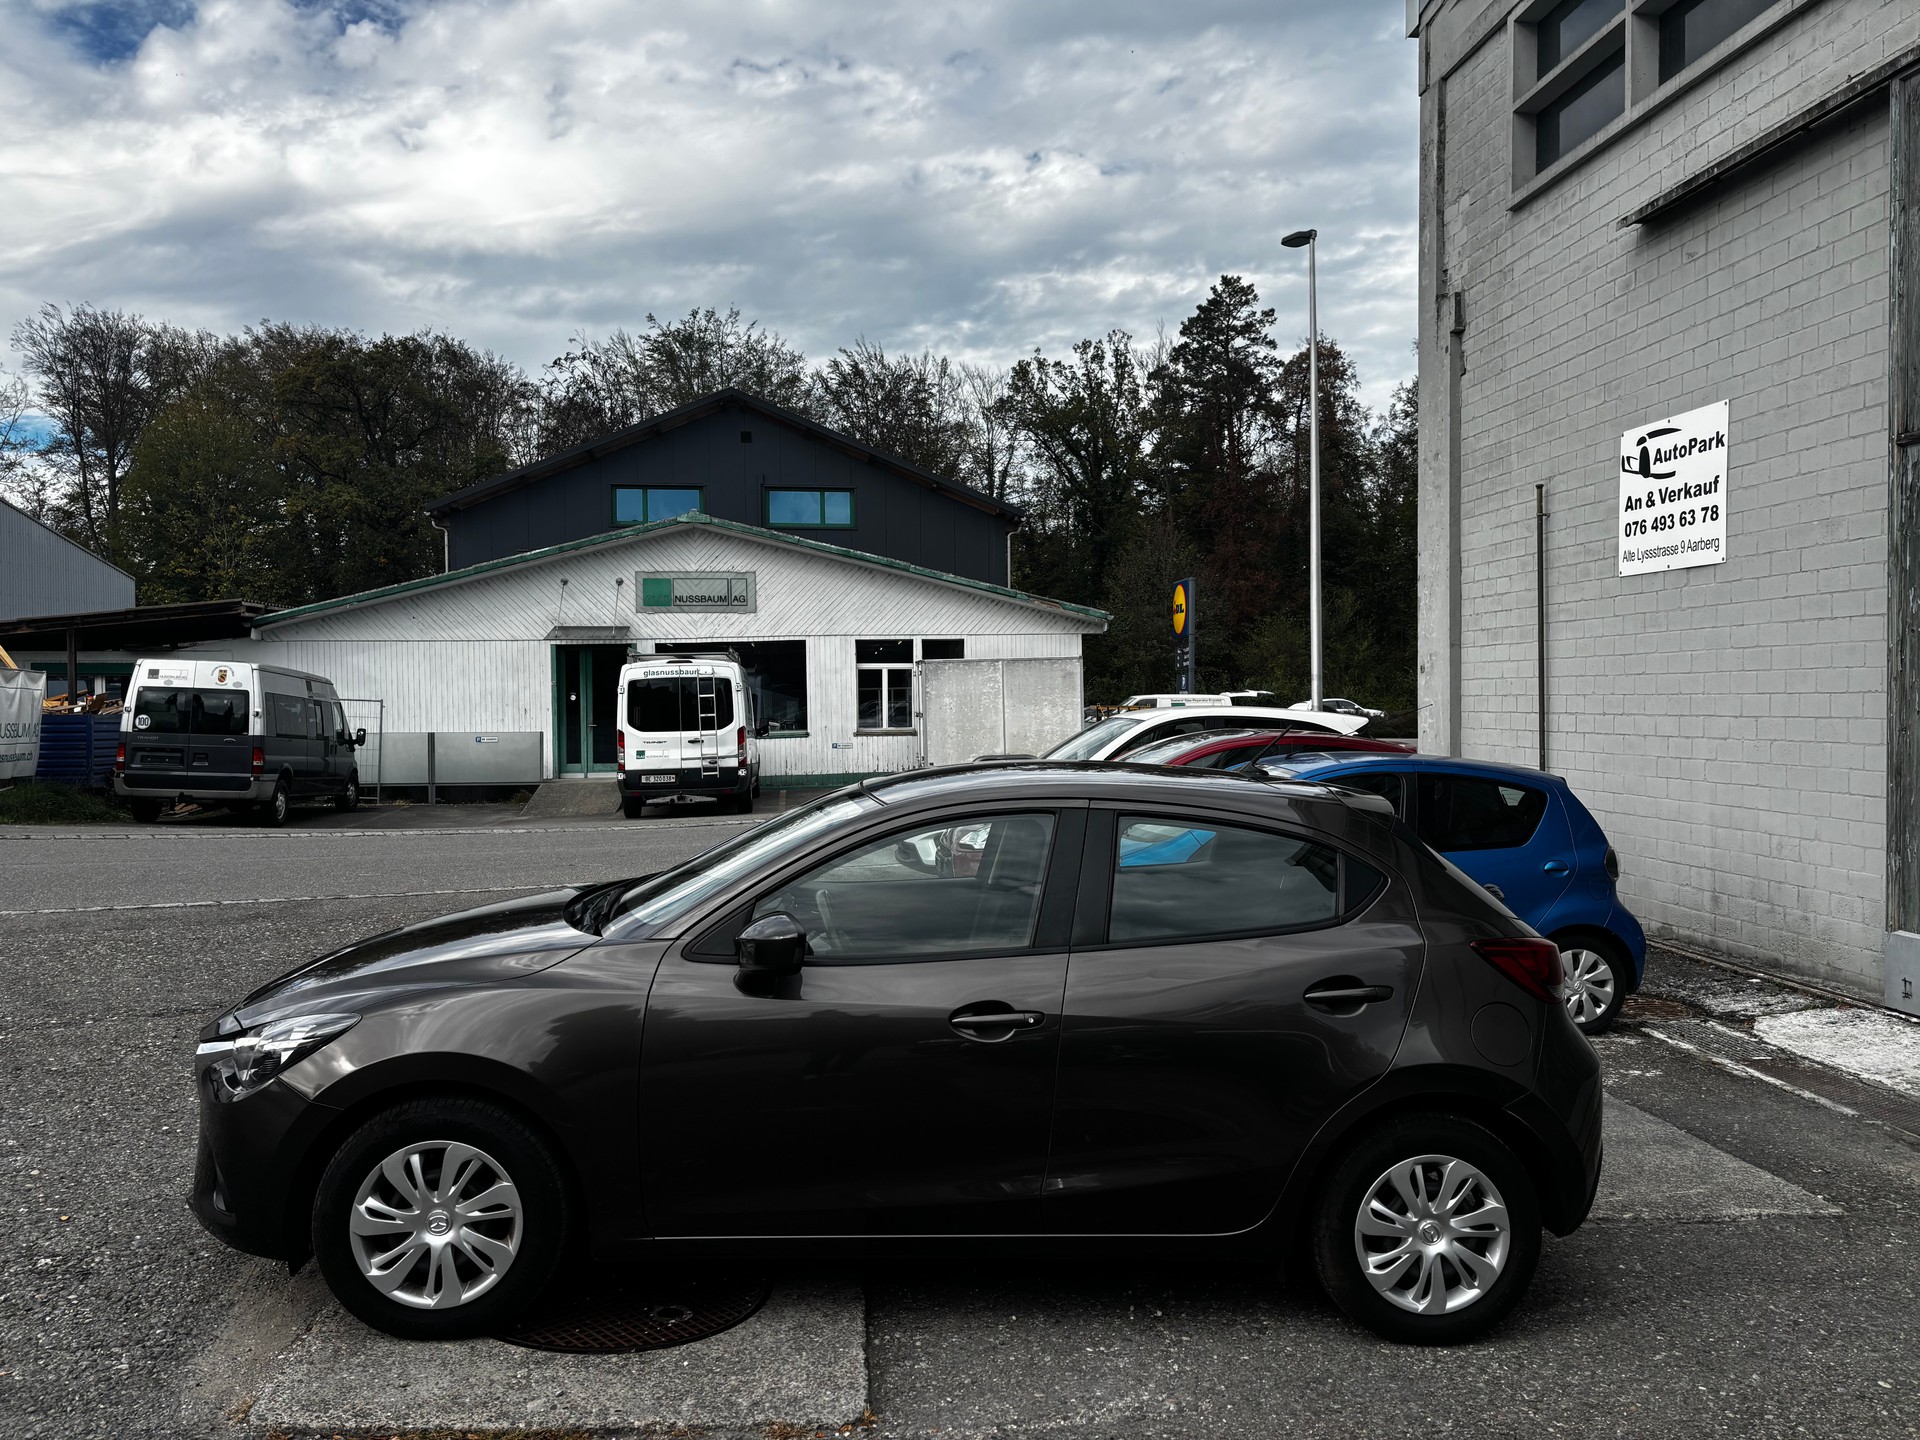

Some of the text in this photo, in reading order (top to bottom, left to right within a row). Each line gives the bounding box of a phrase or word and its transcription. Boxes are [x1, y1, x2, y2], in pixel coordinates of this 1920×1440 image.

[1653, 431, 1725, 465] AutoPark
[1624, 475, 1720, 512] An & Verkauf
[1624, 505, 1719, 537] 076 493 63 78
[1622, 549, 1636, 563] Alte
[1680, 541, 1686, 553] 9
[1686, 536, 1720, 553] Aarberg
[674, 595, 727, 603] NUSSBAUM
[732, 595, 746, 603] AG
[137, 717, 149, 727] 100
